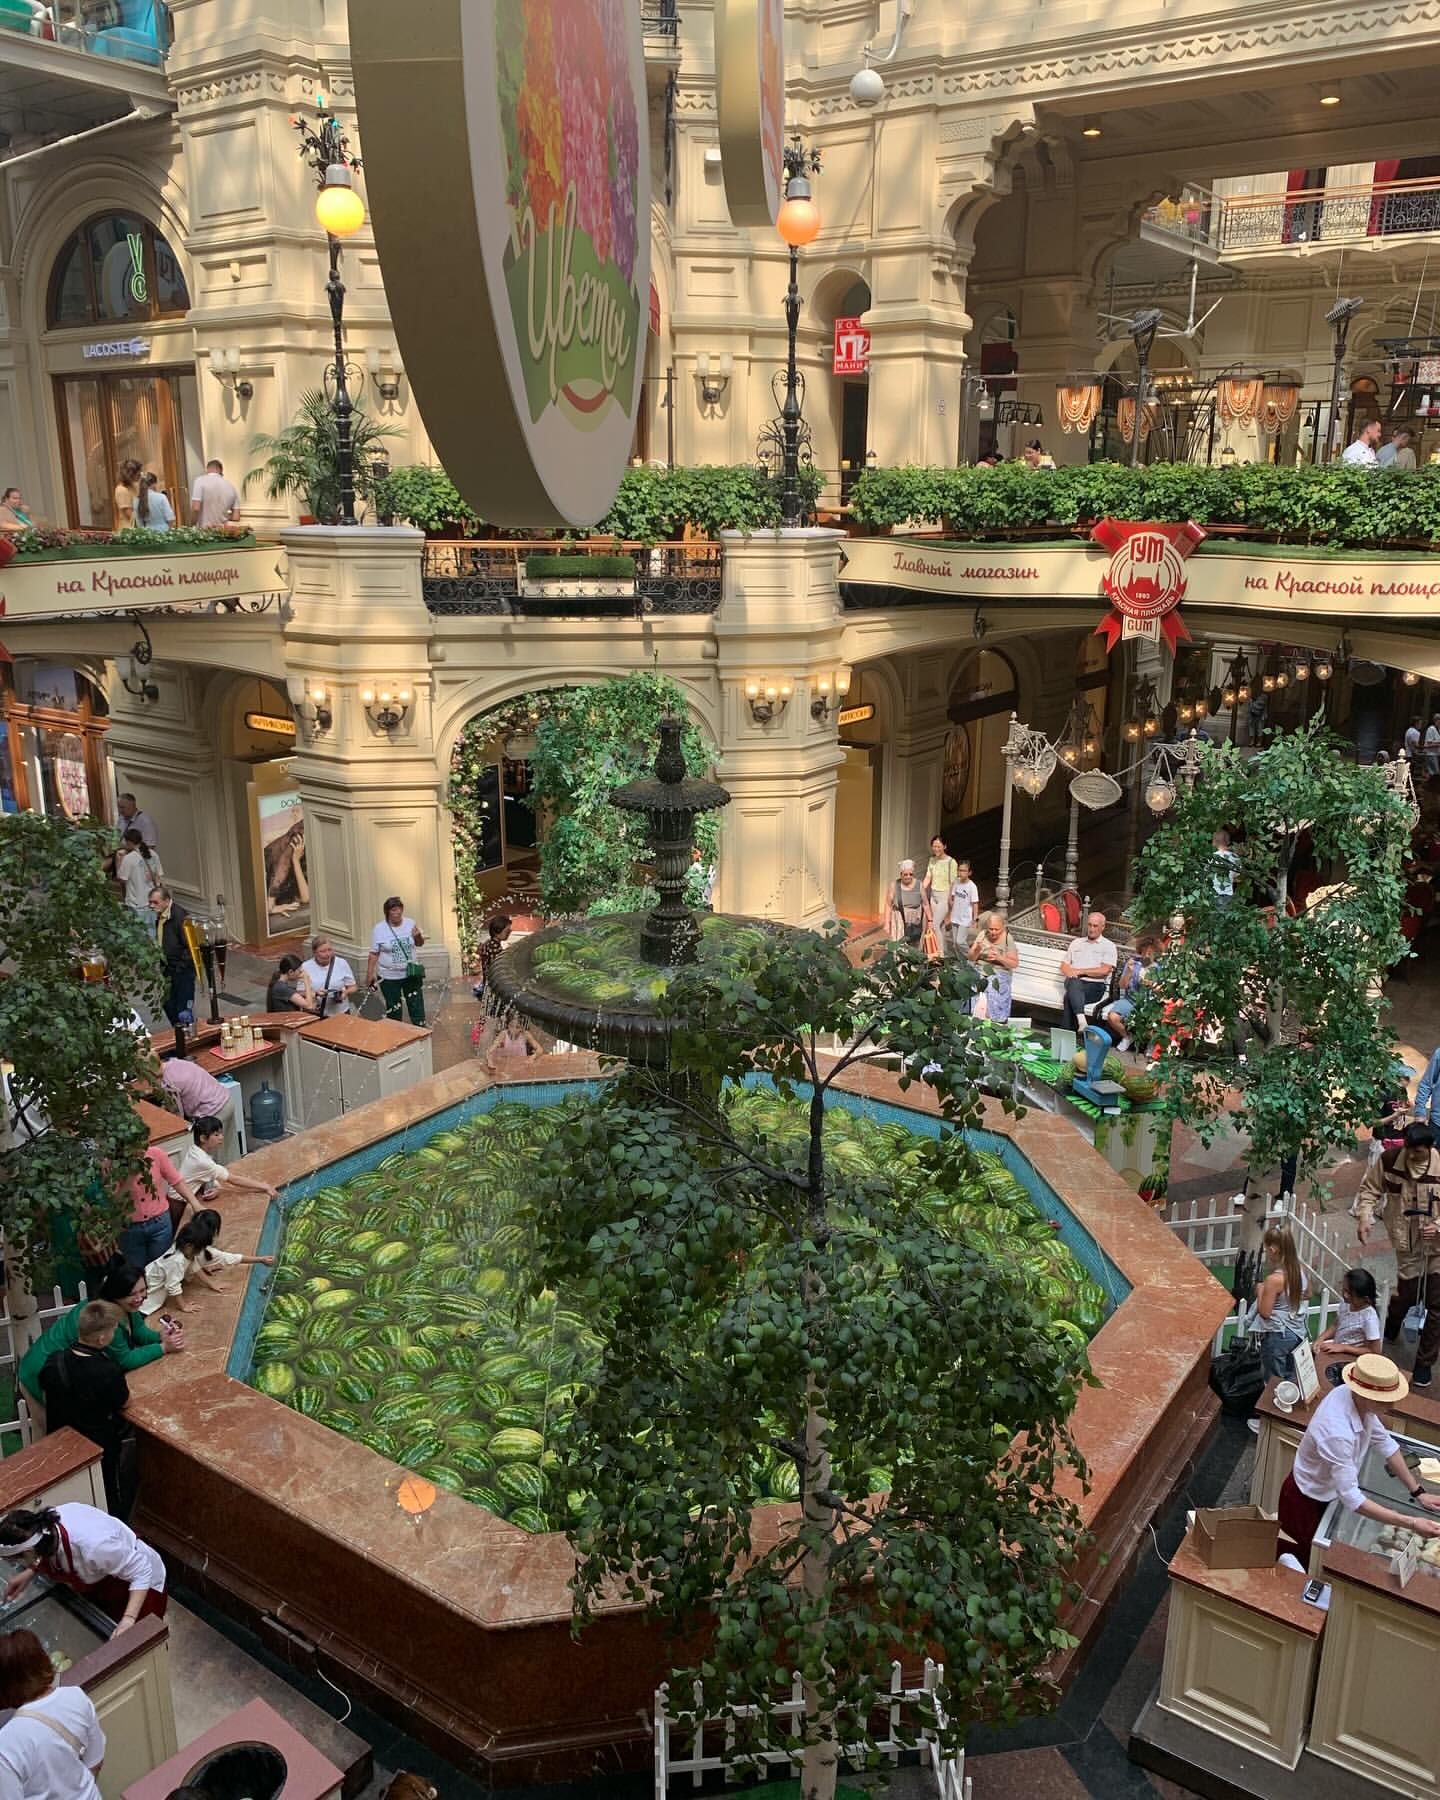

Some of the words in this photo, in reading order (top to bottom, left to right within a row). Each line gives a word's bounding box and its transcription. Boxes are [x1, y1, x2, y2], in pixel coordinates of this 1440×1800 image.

[521, 179, 631, 404] Цветы
[83, 341, 130, 358] LACOSTE
[1131, 536, 1165, 563] ГУМ
[893, 552, 952, 577] Главный
[960, 566, 1040, 579] магазин
[57, 579, 85, 594] на
[91, 568, 174, 596] Красной
[178, 567, 240, 585] площади
[1244, 575, 1269, 590] на
[1274, 570, 1363, 598] Красной
[1112, 591, 1139, 616] КРАСНАЯ
[1140, 594, 1175, 617] ПЛОЩАДЬ
[1128, 619, 1153, 632] GUM
